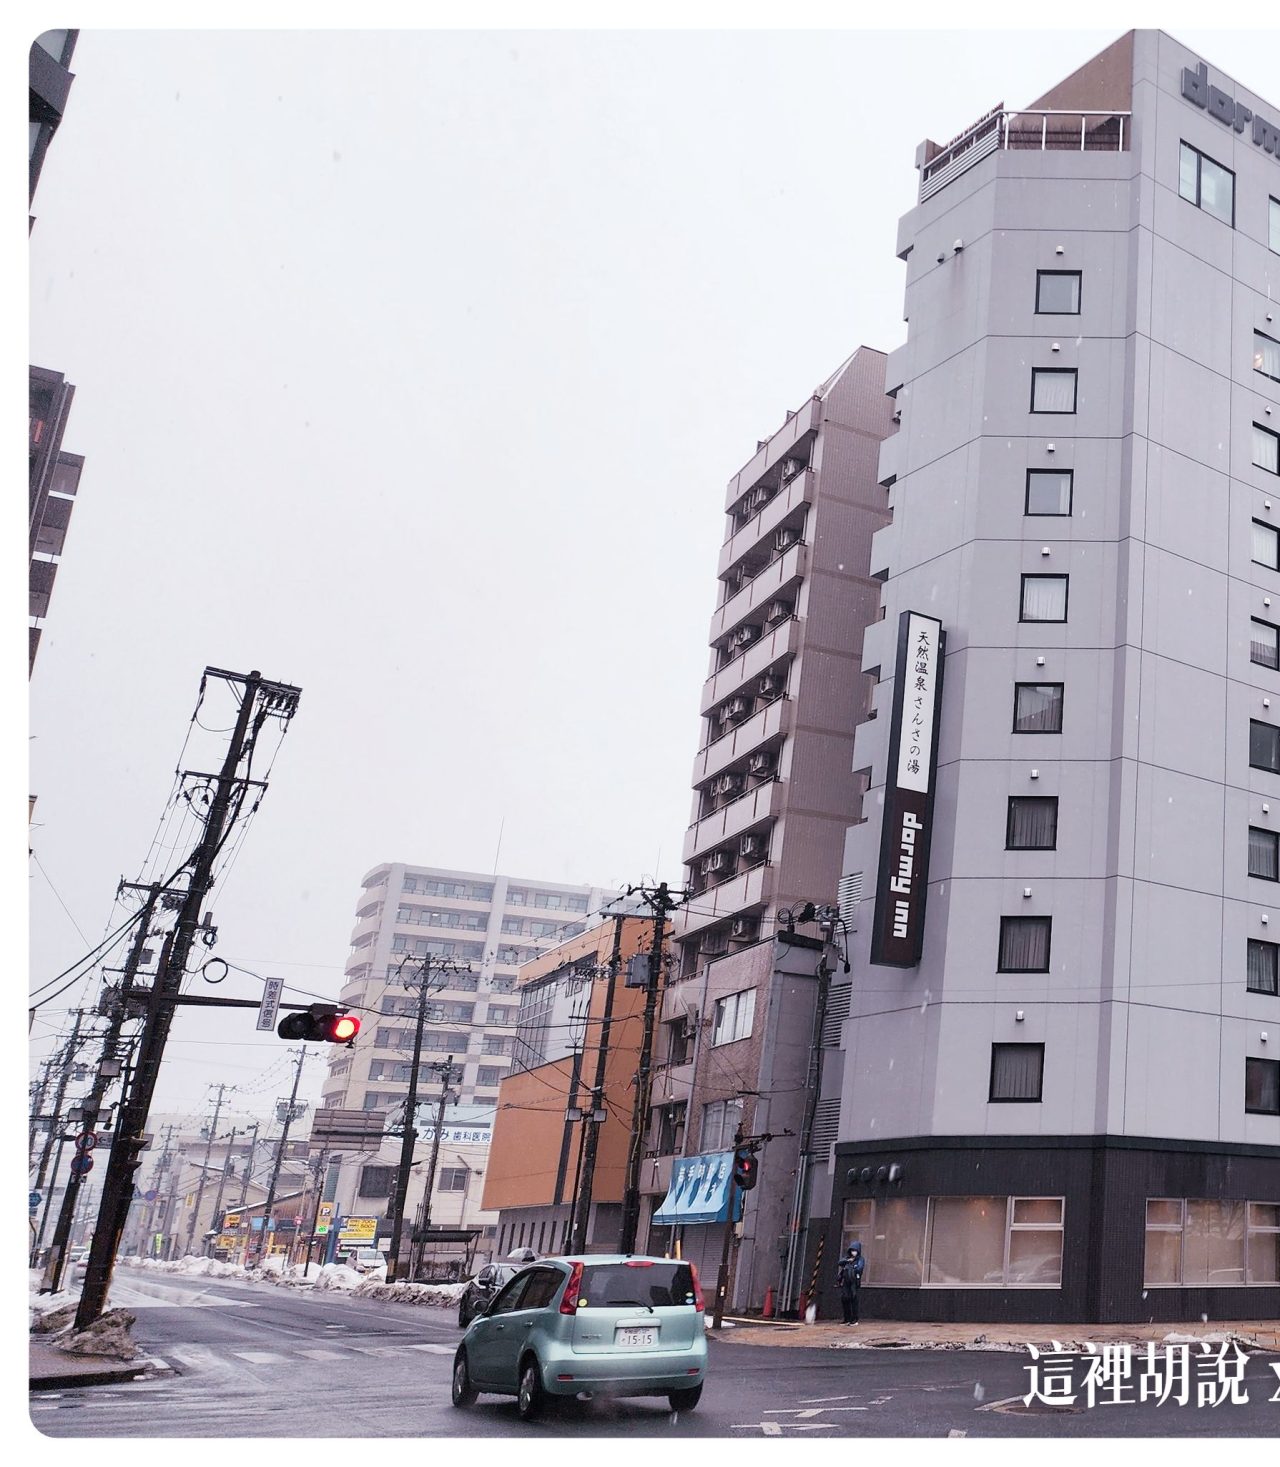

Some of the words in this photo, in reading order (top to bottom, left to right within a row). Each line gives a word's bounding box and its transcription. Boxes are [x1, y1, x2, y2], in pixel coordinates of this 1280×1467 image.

[890, 811, 924, 895] dormy
[892, 899, 910, 939] inn
[453, 1132, 492, 1142] 歯科医院
[321, 1207, 332, 1216] P
[626, 1335, 653, 1345] 15-15
